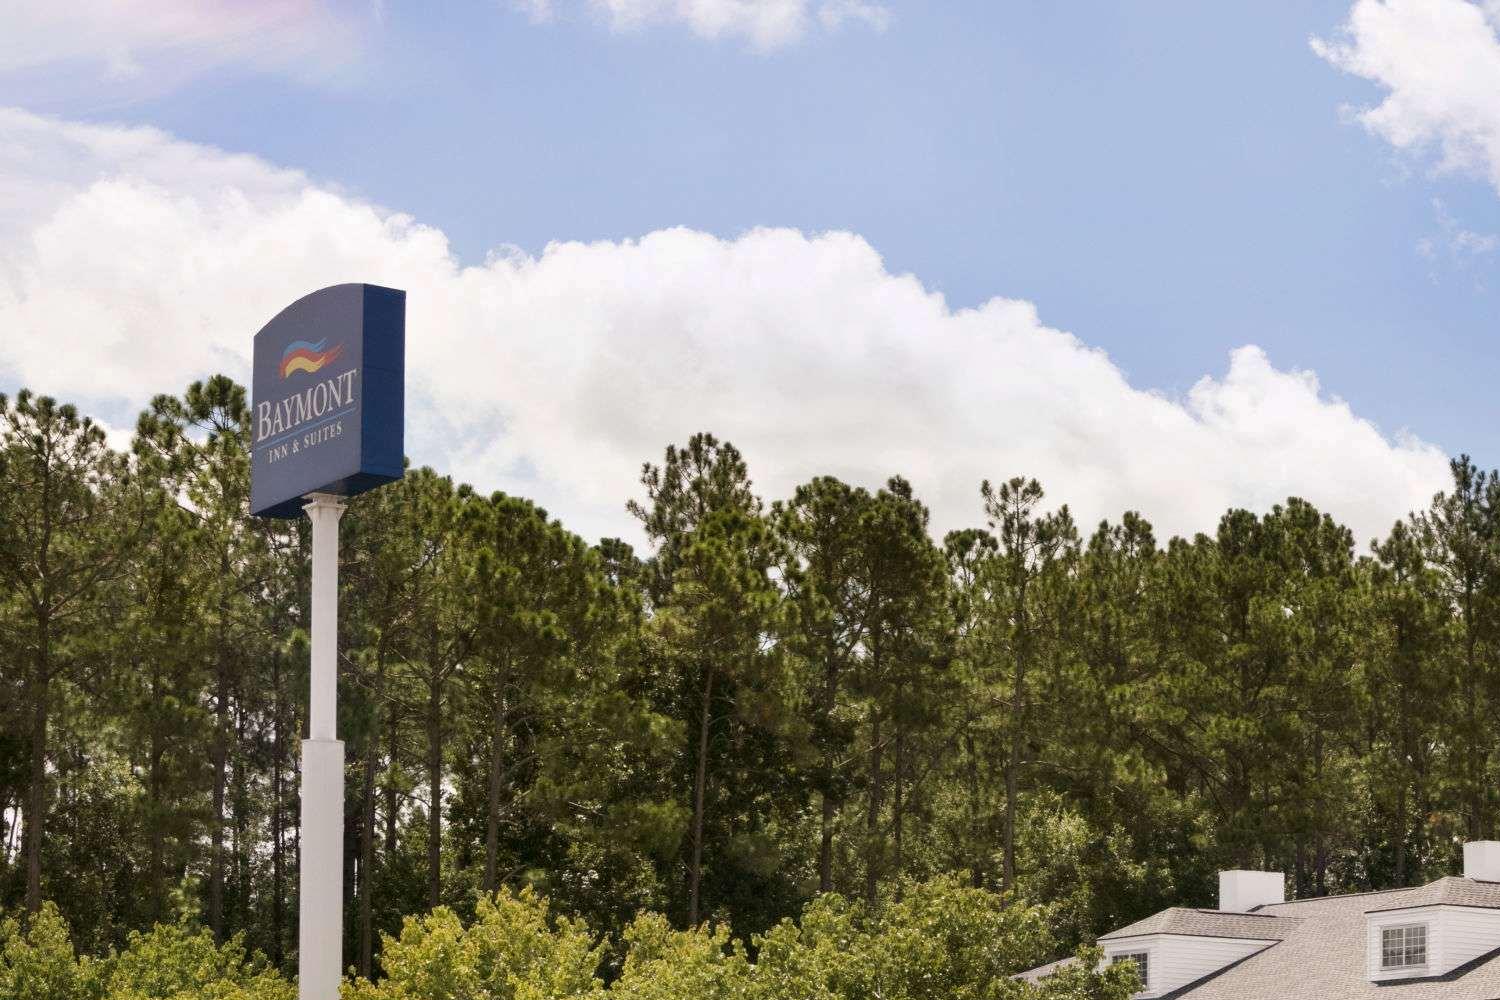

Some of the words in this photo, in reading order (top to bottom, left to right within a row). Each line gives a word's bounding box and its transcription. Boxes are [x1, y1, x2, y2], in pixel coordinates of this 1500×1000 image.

[257, 369, 357, 442] BAYMONT
[268, 444, 288, 464] INN
[292, 440, 300, 454] &
[303, 420, 343, 449] SUITES
